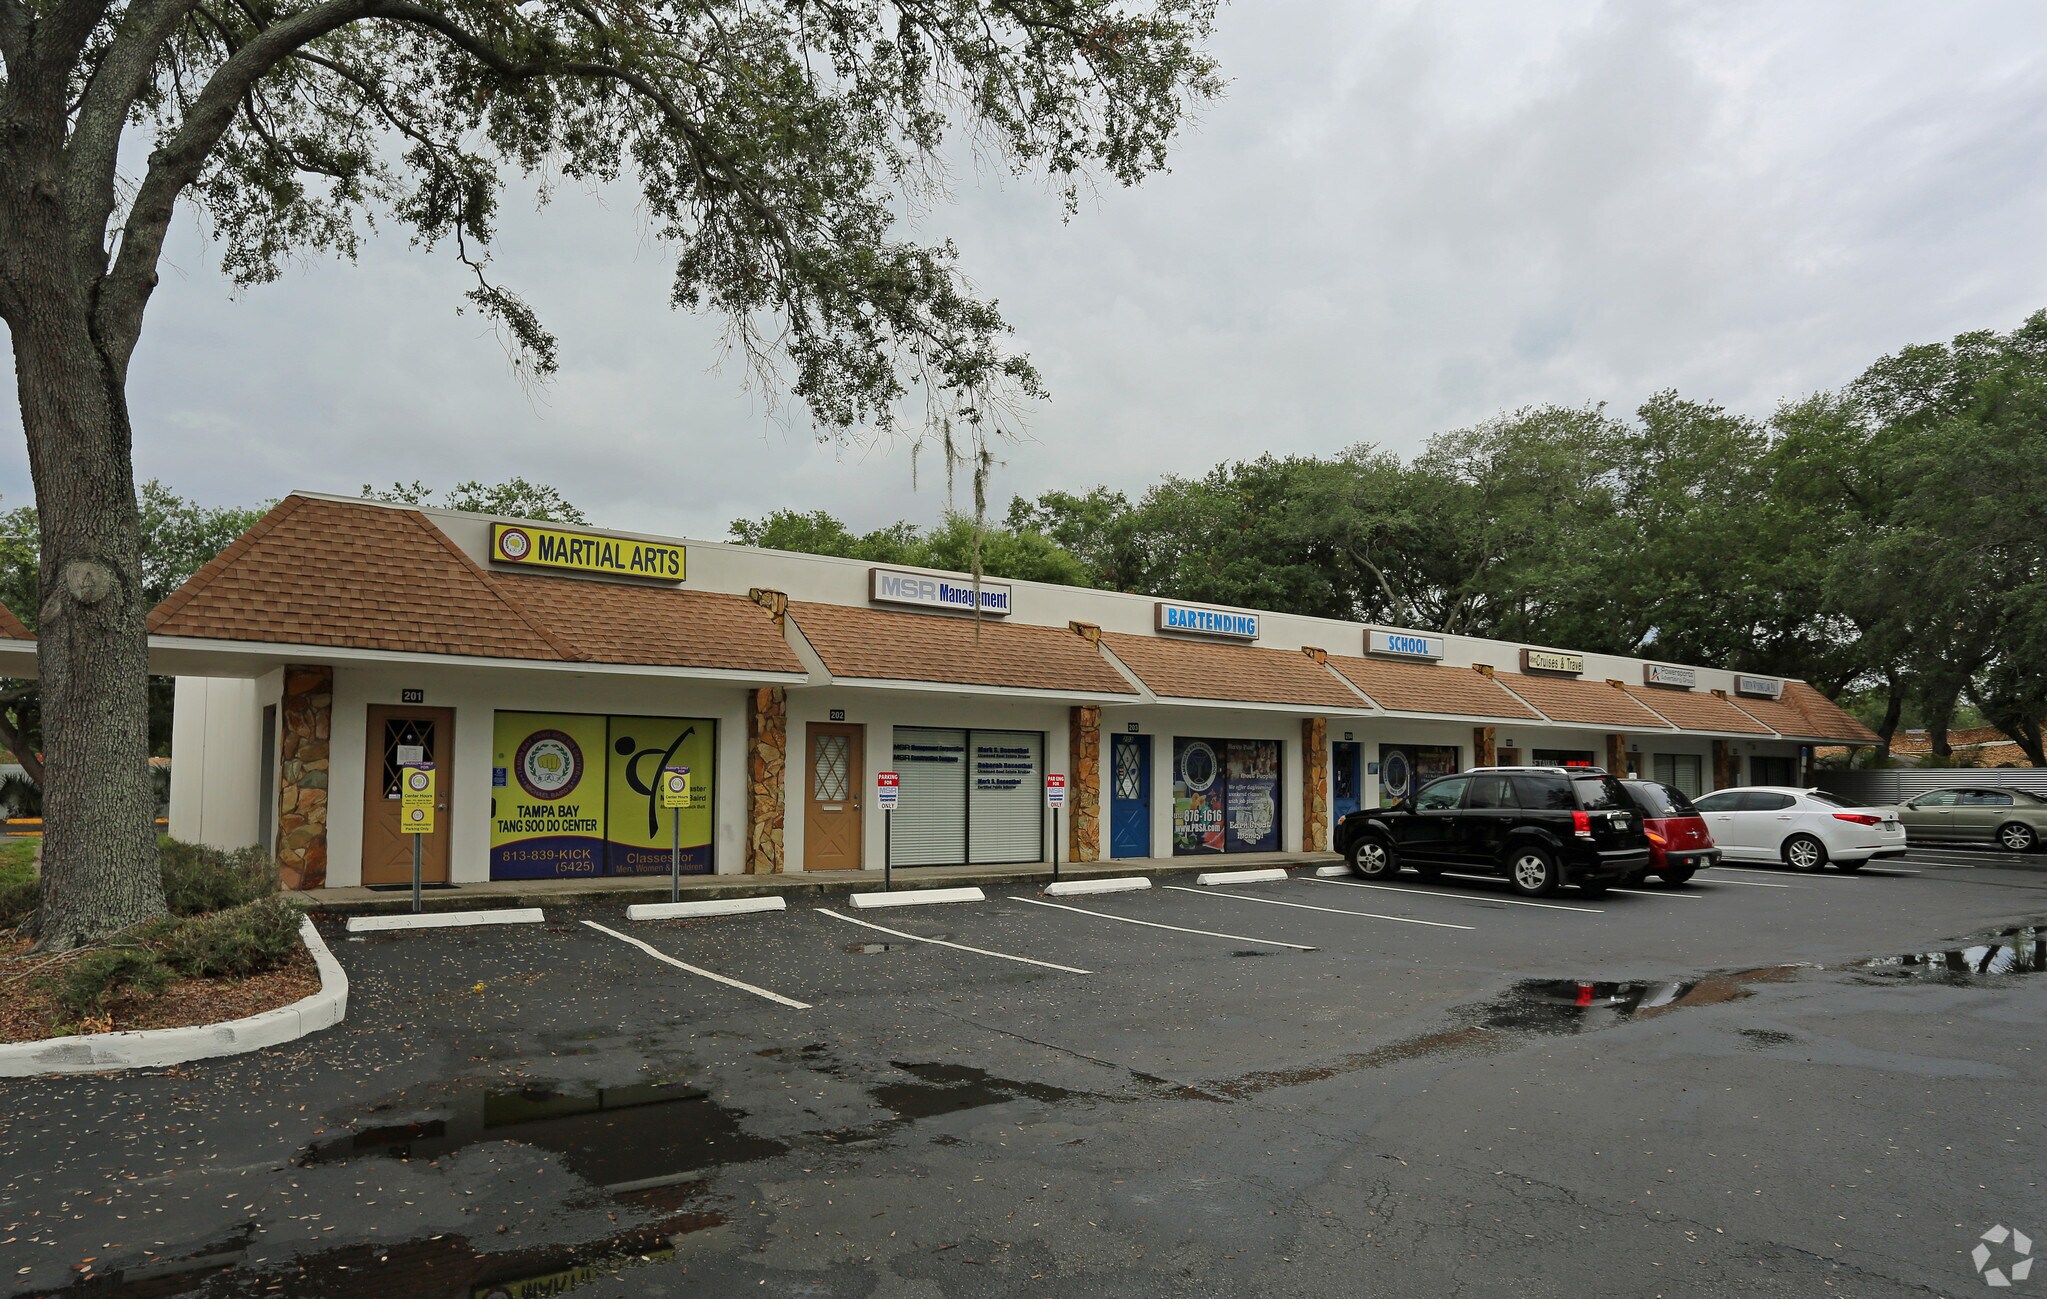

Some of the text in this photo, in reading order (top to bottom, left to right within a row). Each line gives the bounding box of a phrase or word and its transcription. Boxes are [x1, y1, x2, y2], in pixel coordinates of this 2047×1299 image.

[538, 534, 626, 570] MARTIAL
[630, 545, 680, 575] ARTS
[881, 576, 1007, 609] MSR Managment
[1168, 607, 1255, 635] BARTENDING
[1388, 635, 1429, 655] SCHOOL
[1536, 654, 1558, 668] Cruises
[1560, 657, 1564, 669] &
[1566, 658, 1583, 671] Travel
[404, 691, 421, 701] 201
[831, 711, 844, 720] 202
[1128, 724, 1138, 732] 203
[517, 805, 580, 819] TAMPA BAY
[1184, 810, 1222, 822] 876-1616
[497, 819, 597, 833] TANG SOO DO CENTER
[1175, 823, 1220, 832] www.PBSA.com
[502, 849, 591, 861] 813-839-KICK
[626, 852, 673, 864] Classes
[555, 862, 595, 873] (5425)
[636, 864, 664, 873] Women
